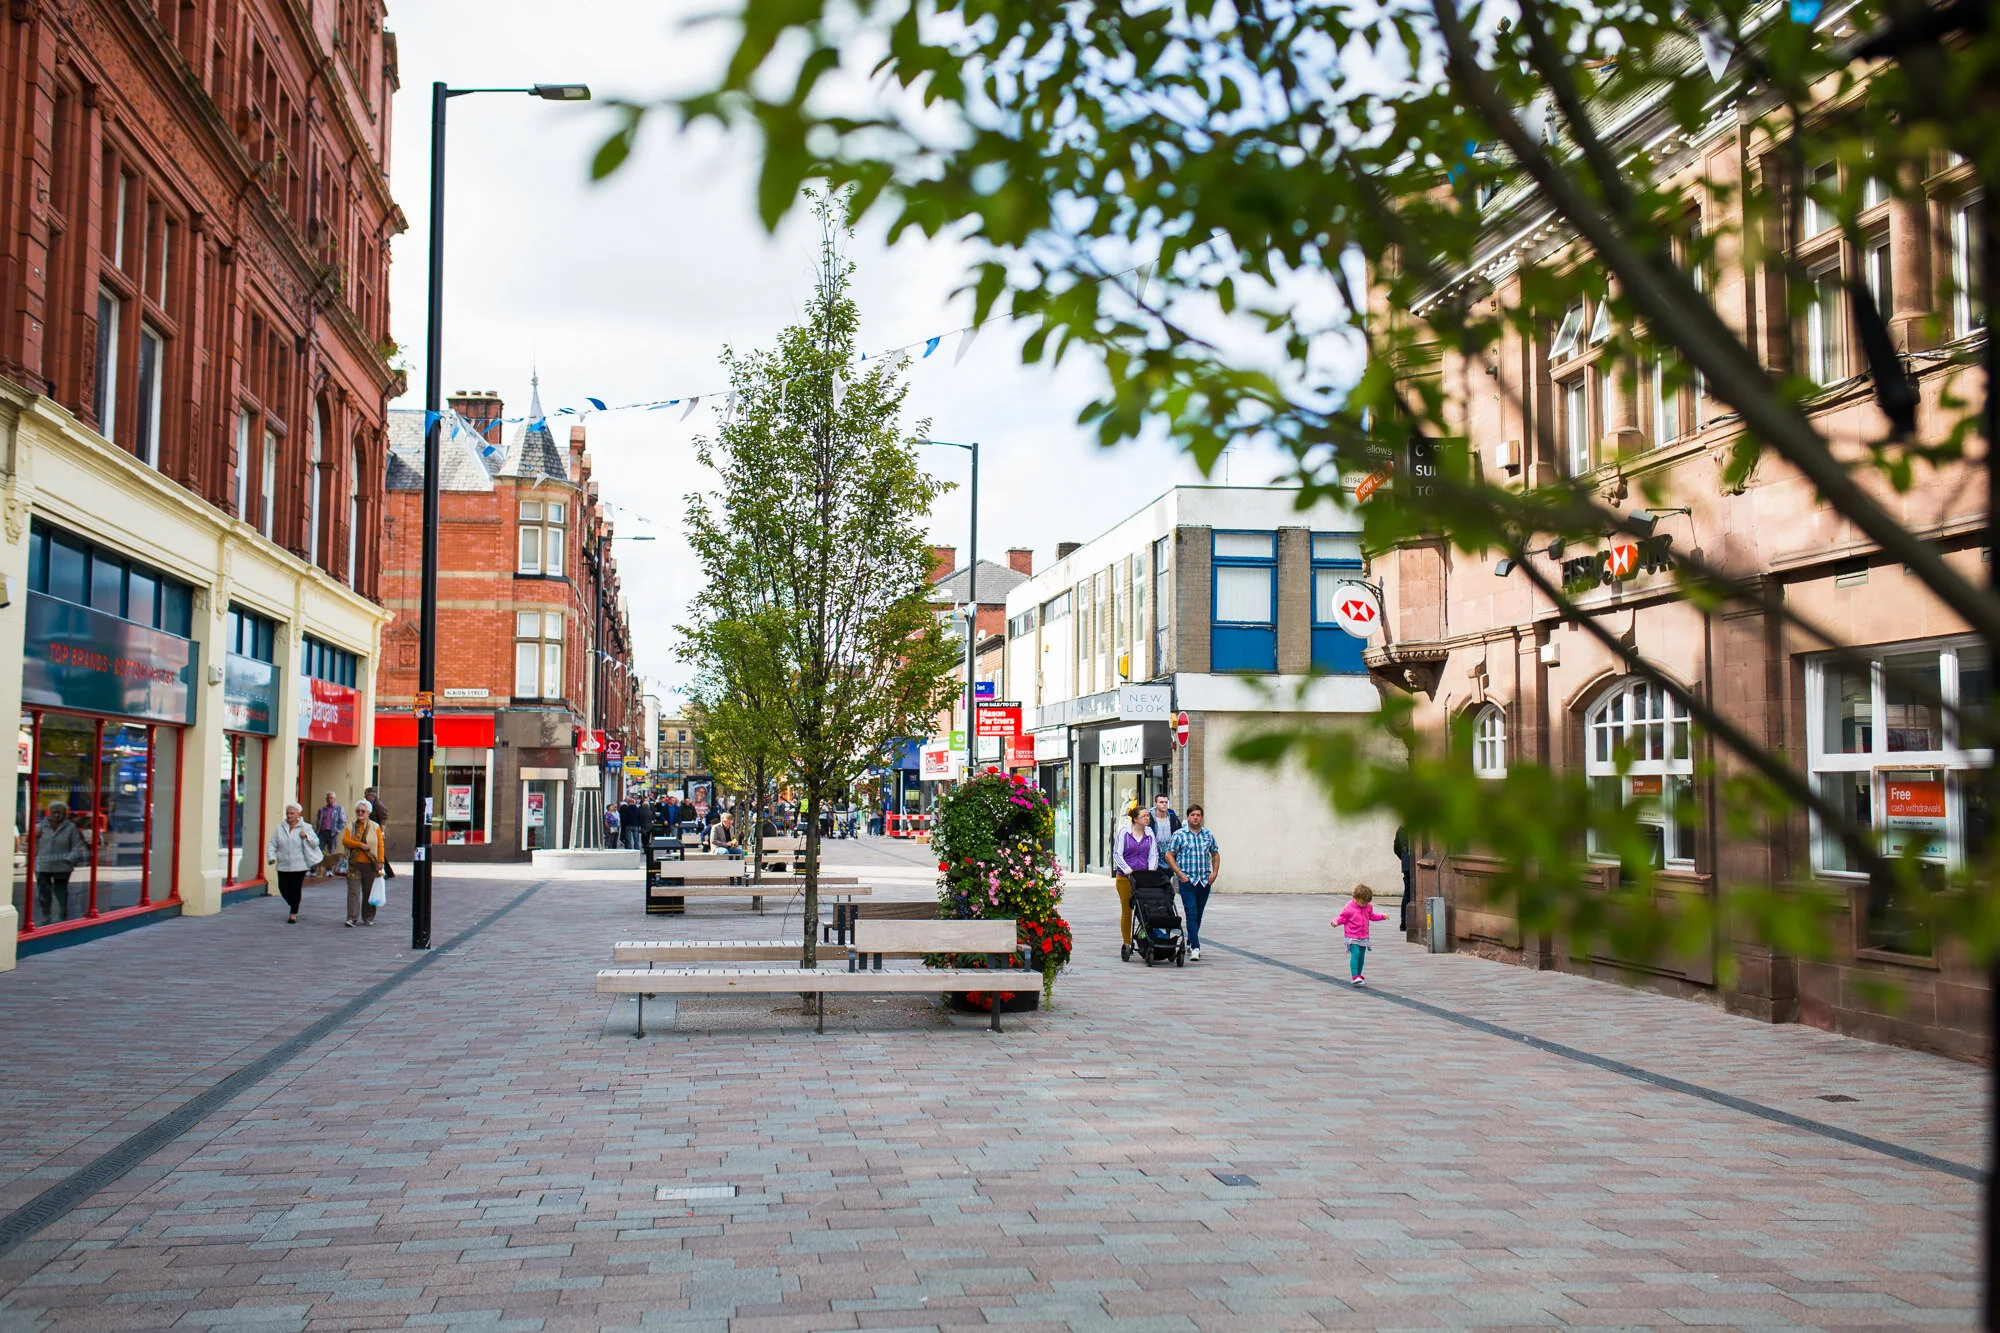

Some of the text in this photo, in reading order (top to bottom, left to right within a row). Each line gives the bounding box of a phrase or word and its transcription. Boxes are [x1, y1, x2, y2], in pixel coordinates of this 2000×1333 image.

[1367, 445, 1392, 456] ellows
[1415, 465, 1437, 476] SUI
[1359, 480, 1373, 497] NOW
[50, 643, 69, 664] TOP
[72, 648, 109, 672] BRANDS
[114, 657, 146, 680] BOTTOM
[148, 666, 175, 686] PRICES
[1129, 694, 1162, 703] NEW
[299, 698, 312, 719] ome
[313, 694, 338, 728] bargains
[1126, 704, 1165, 713] LOOK
[979, 717, 1015, 725] Partners
[1101, 737, 1140, 756] NEW LOOK
[1891, 787, 1911, 800] Free
[1891, 803, 1941, 813] cash withdrawals
